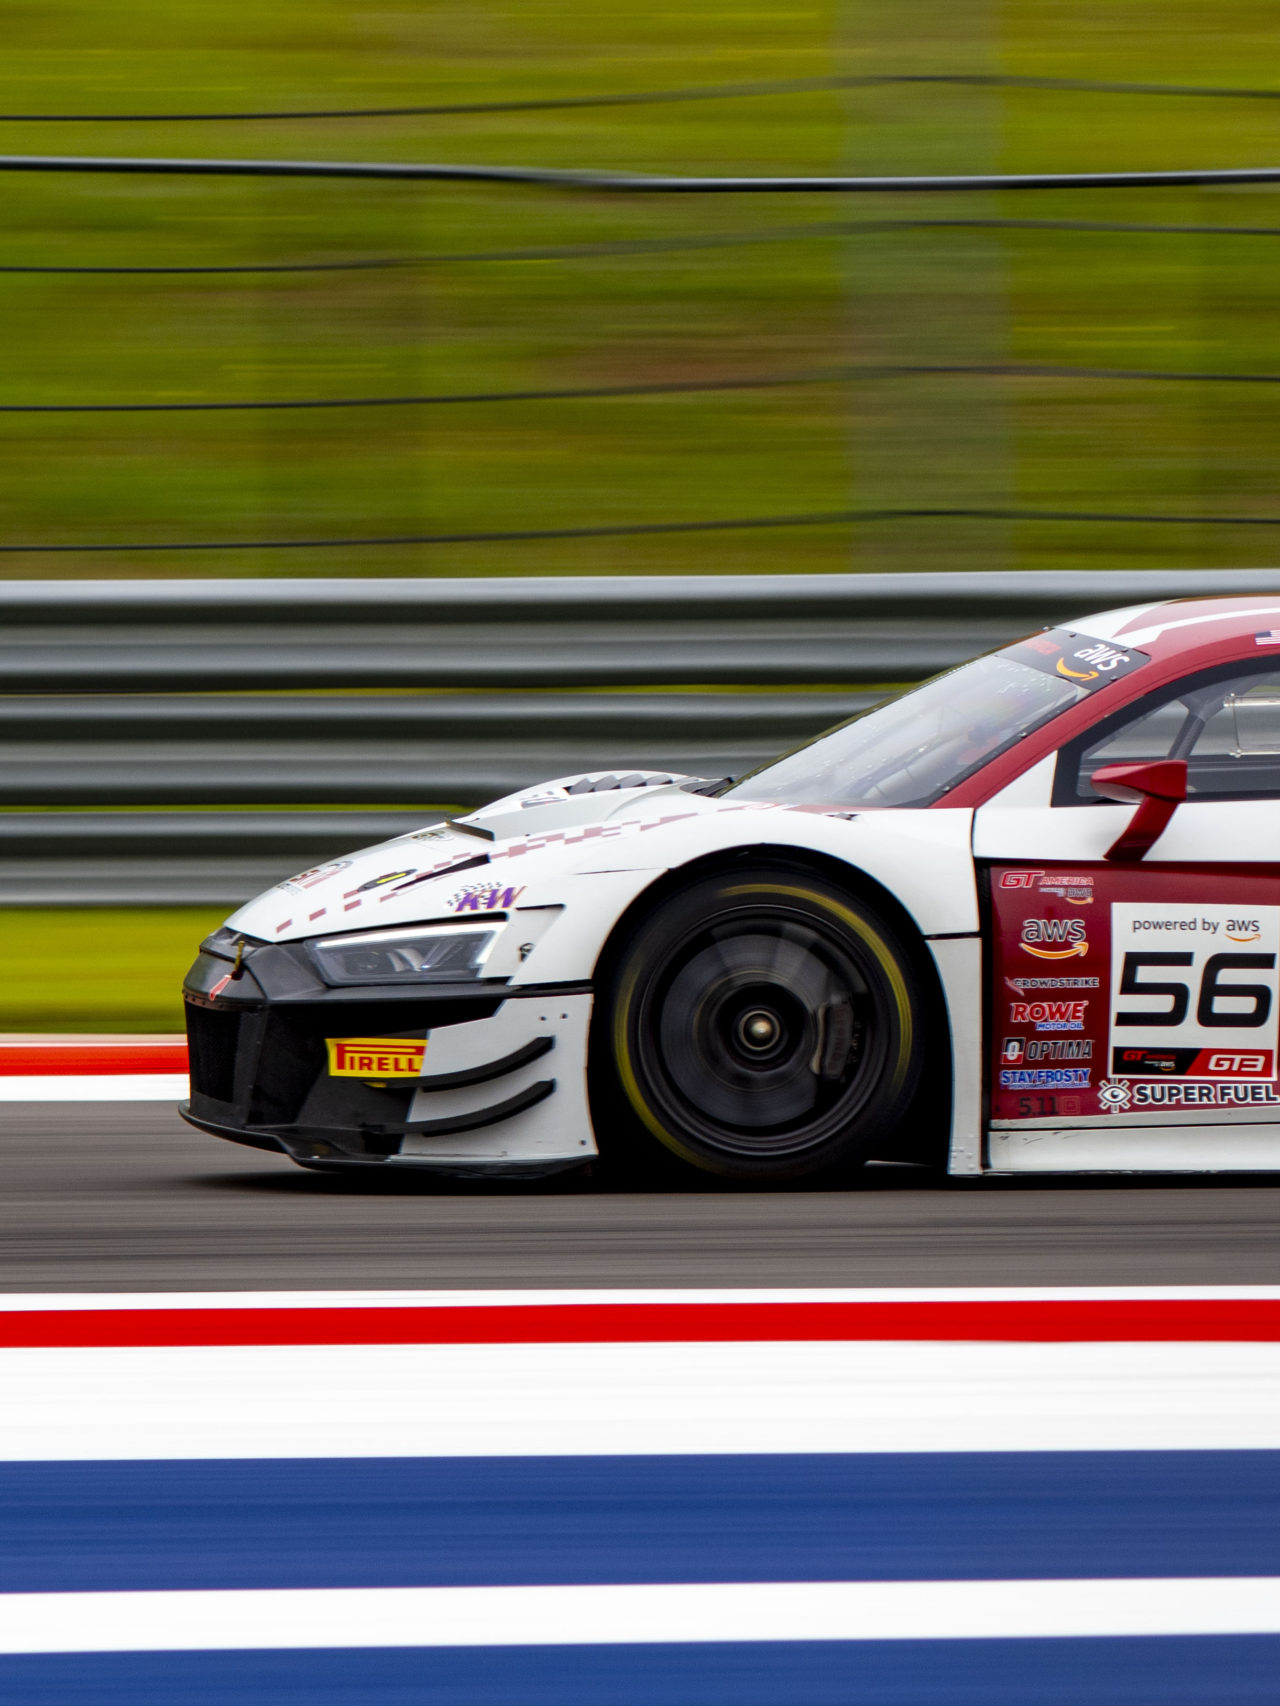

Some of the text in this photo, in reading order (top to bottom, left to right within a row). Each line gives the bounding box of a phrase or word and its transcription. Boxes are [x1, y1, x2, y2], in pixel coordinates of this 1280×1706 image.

[1073, 643, 1130, 671] aws
[1000, 870, 1046, 889] GT
[455, 885, 528, 912] KW
[1022, 919, 1087, 943] aws
[1132, 918, 1260, 934] powered by aws
[1013, 977, 1100, 988] CROWDSTRIKE
[1115, 951, 1277, 1028] 56
[1010, 1001, 1087, 1022] ROWE
[335, 1043, 426, 1073] PIRELL
[1026, 1040, 1094, 1060] OPTIMA
[1208, 1054, 1266, 1072] GT3
[1000, 1068, 1091, 1085] STAY FROSTY
[1134, 1084, 1216, 1104] SUPER
[1018, 1096, 1058, 1116] 5.11
